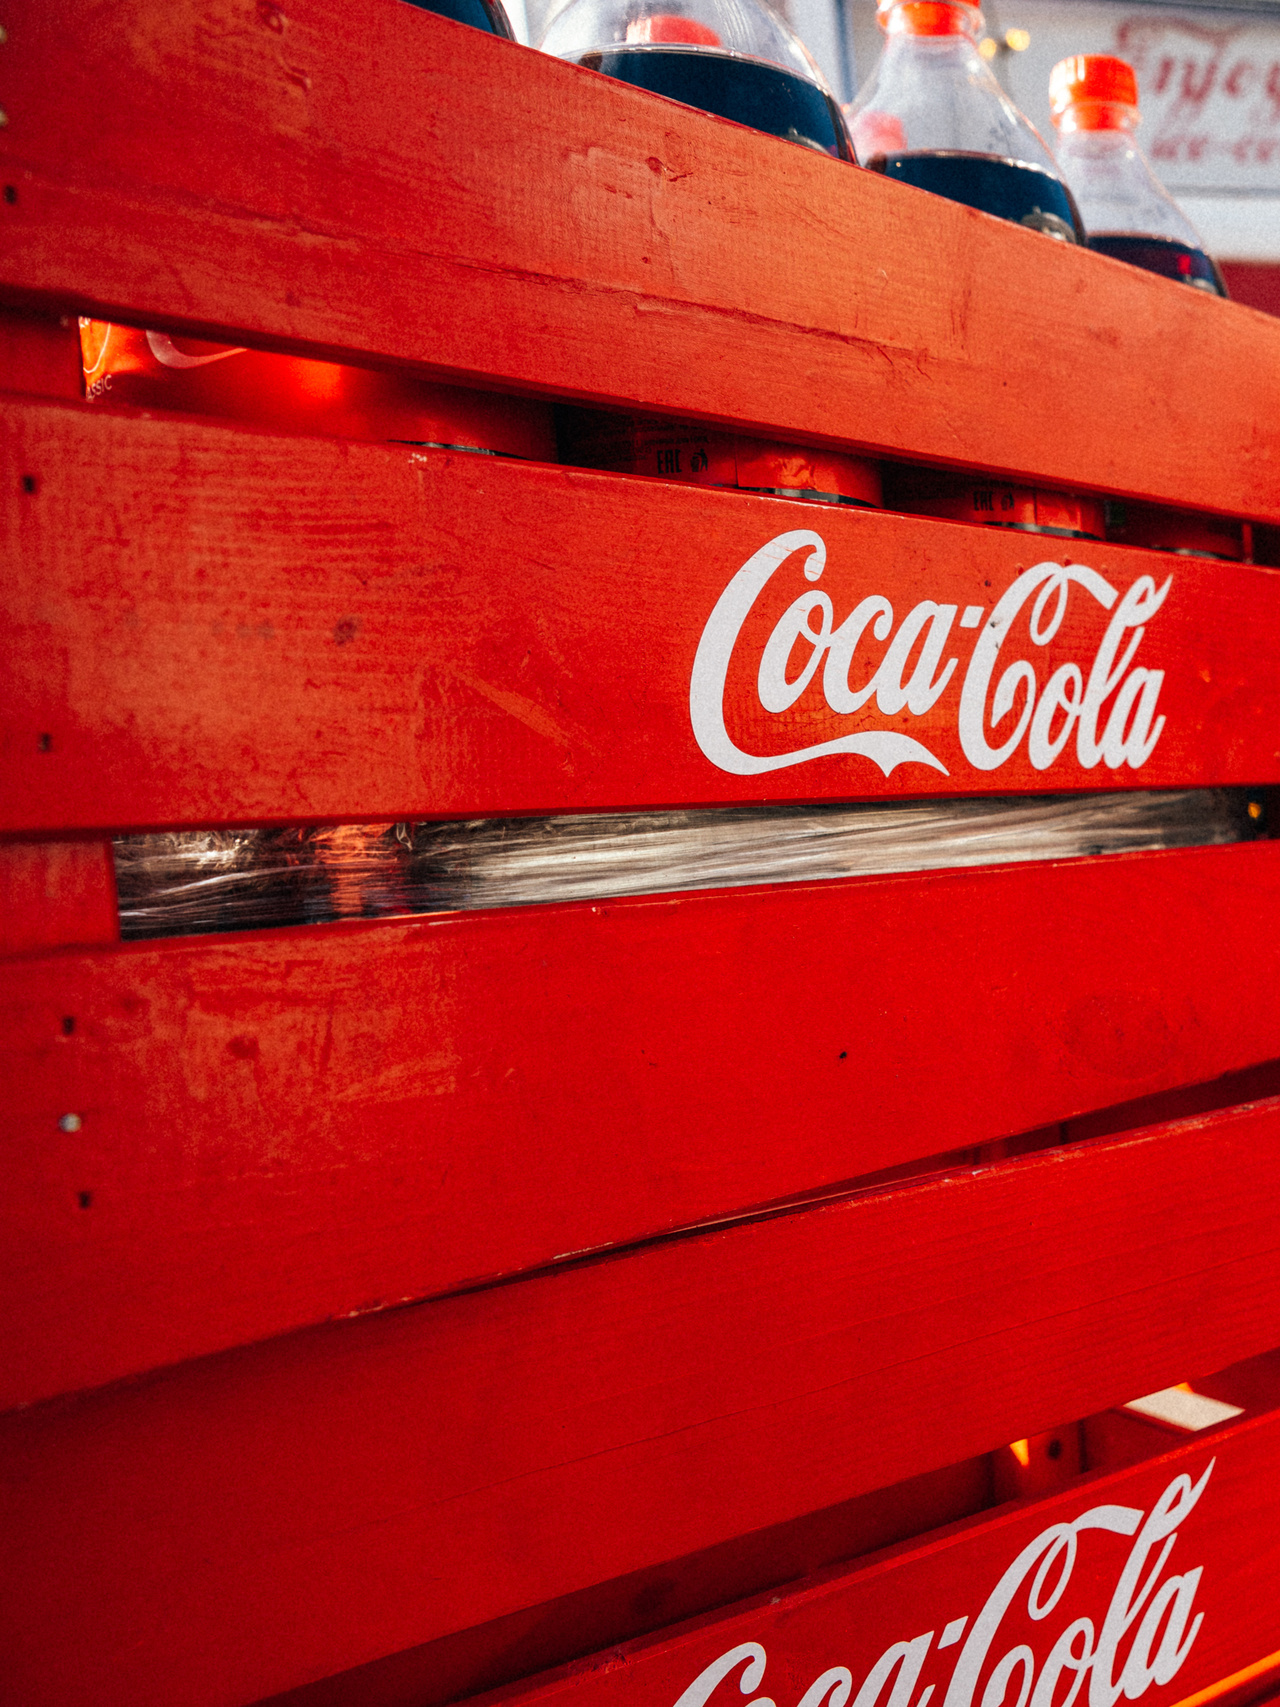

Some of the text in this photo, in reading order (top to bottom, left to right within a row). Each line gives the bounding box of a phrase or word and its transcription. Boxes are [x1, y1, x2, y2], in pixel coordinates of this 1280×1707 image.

[86, 374, 112, 403] ASSIC
[689, 529, 1173, 777] Coca-Cola
[673, 1456, 1216, 1707] a-Cola
